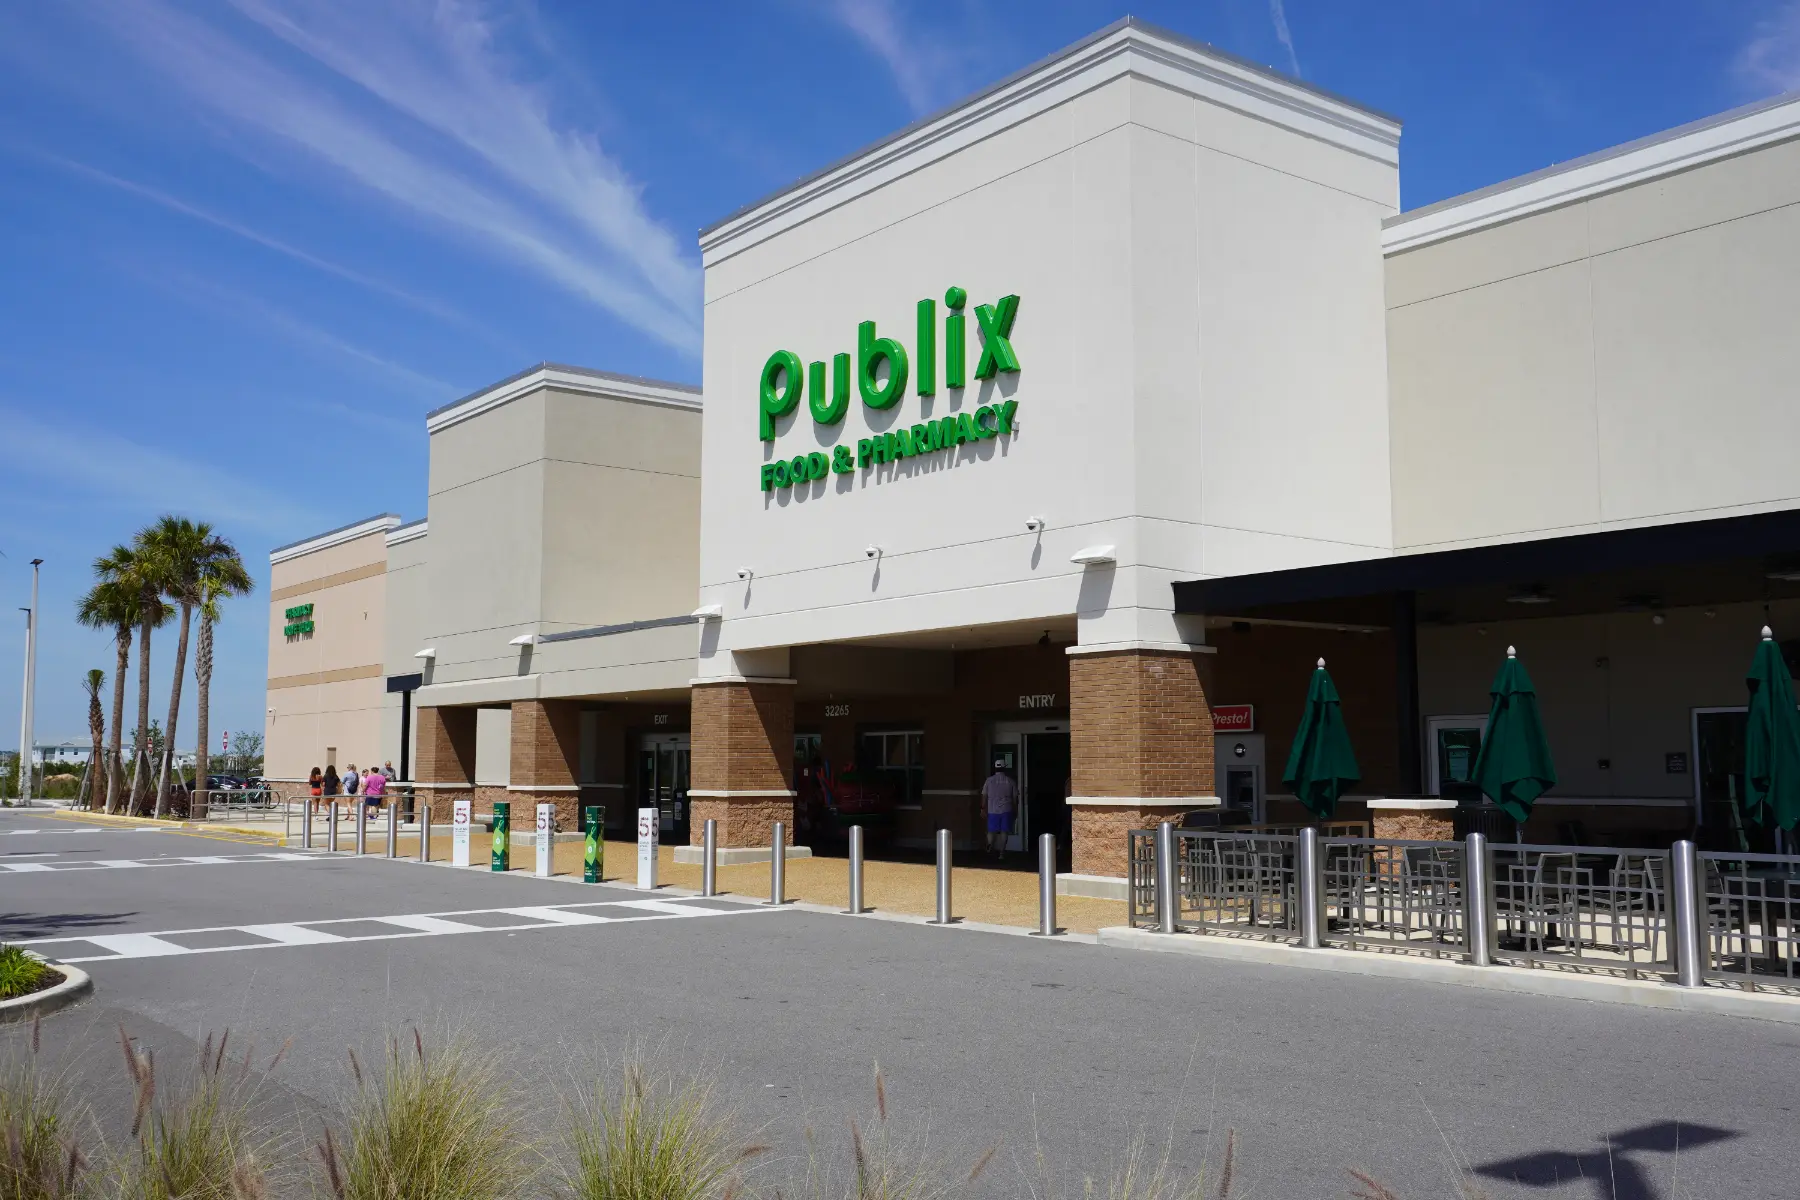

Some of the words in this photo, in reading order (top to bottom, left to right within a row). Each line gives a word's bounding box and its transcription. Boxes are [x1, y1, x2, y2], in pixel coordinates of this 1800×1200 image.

[759, 286, 1021, 442] publix
[760, 451, 830, 492] FOOD
[831, 445, 855, 474] &
[857, 400, 1019, 469] PHARMACY
[1019, 694, 1055, 709] ENTRY
[825, 705, 849, 717] 32265
[654, 714, 668, 725] EXIT
